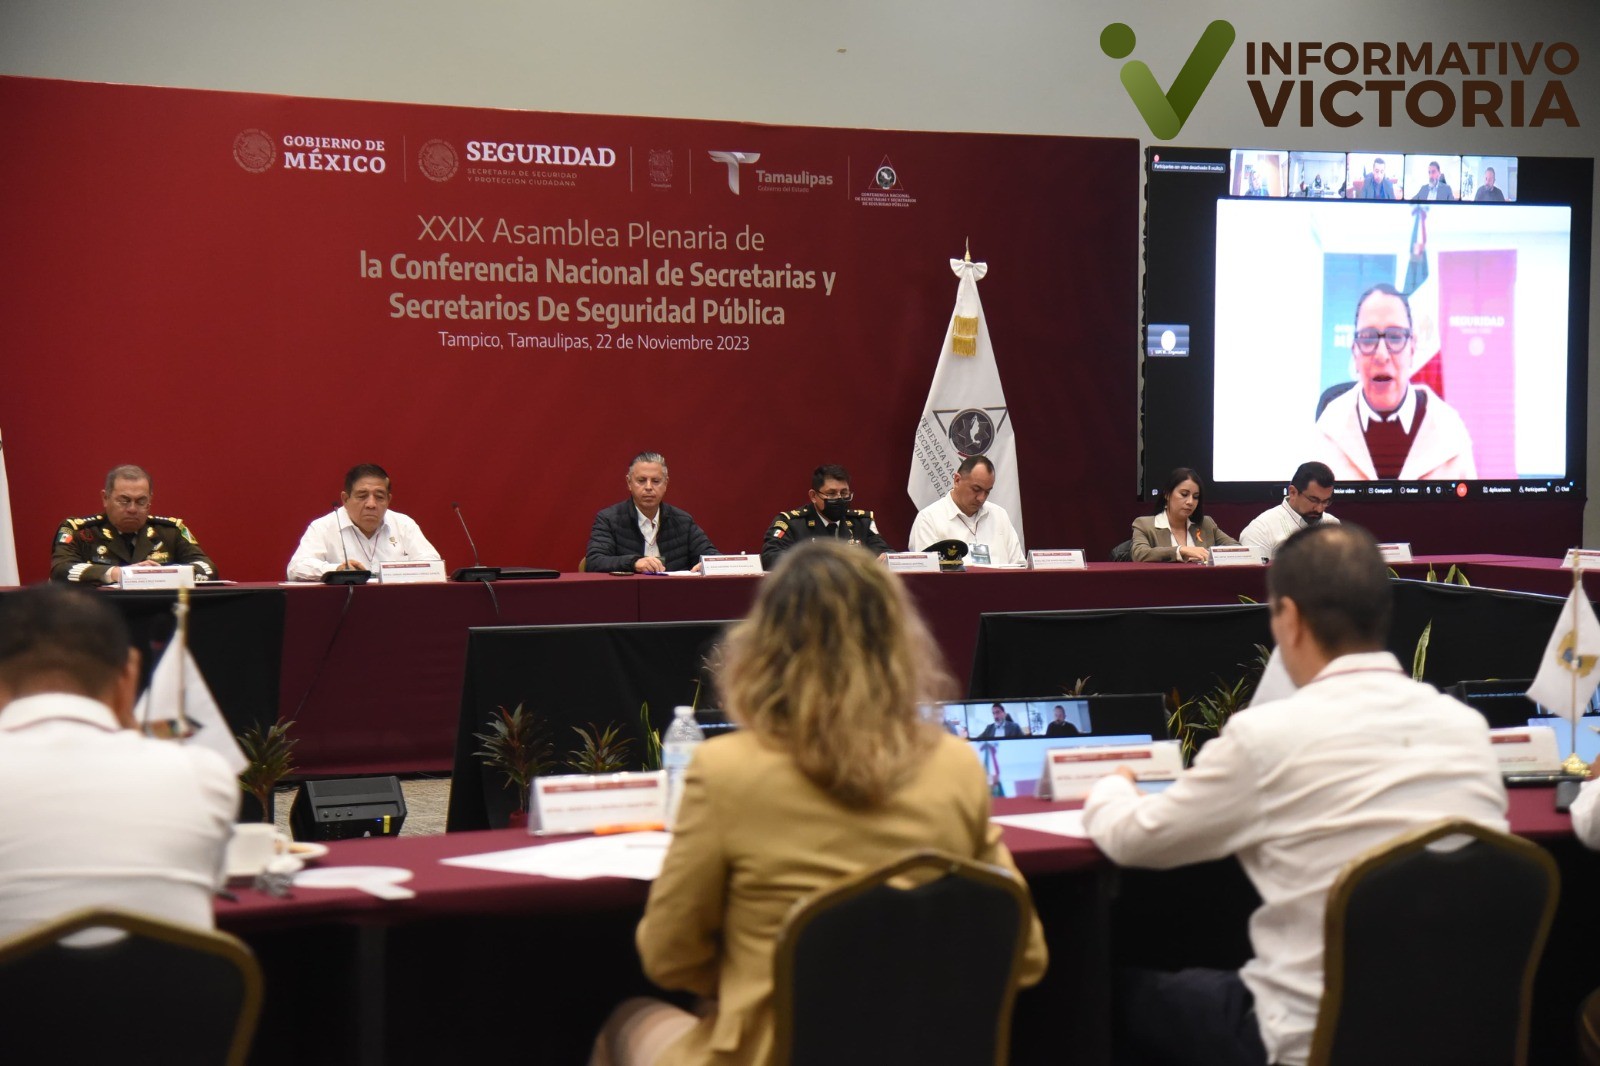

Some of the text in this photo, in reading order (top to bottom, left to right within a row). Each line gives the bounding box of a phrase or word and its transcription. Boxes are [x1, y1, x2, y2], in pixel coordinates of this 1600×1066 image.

[283, 135, 385, 151] GOBIERNO DE
[466, 140, 616, 167] SEGURIDAD
[283, 148, 386, 174] MÉXICO
[528, 179, 576, 187] CIUDADANA
[532, 171, 578, 179] SEGURIDAD
[755, 170, 834, 188] Tamaulipas
[417, 215, 765, 251] XXIX Asamblea Plenaria de
[360, 250, 837, 296] la Conferencia Nacional de Secretarias y
[389, 292, 785, 329] Secretarios De Seguridad Pública
[438, 331, 750, 352] Tampico, Tamaulipas, 22 de Noviembre 2023
